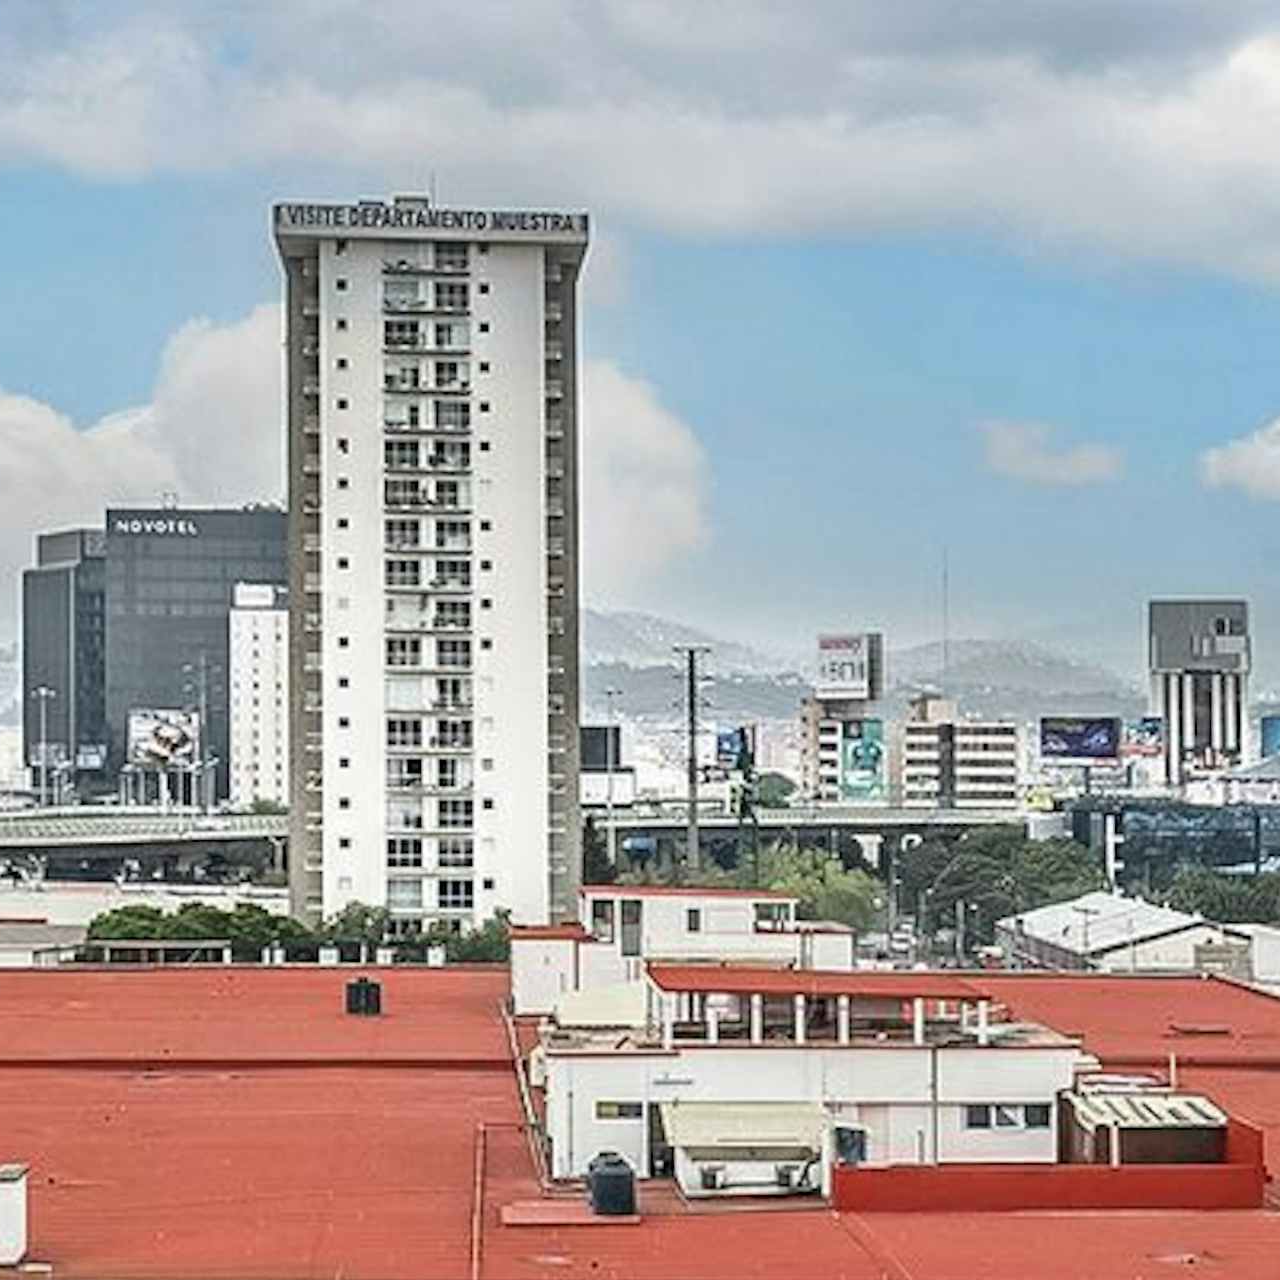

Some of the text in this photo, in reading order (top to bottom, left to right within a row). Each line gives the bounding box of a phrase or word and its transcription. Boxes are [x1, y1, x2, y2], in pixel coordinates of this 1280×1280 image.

[287, 206, 575, 232] VISITE DEPARTAMENTO MUESTRA
[116, 519, 198, 536] NOVOTEL
